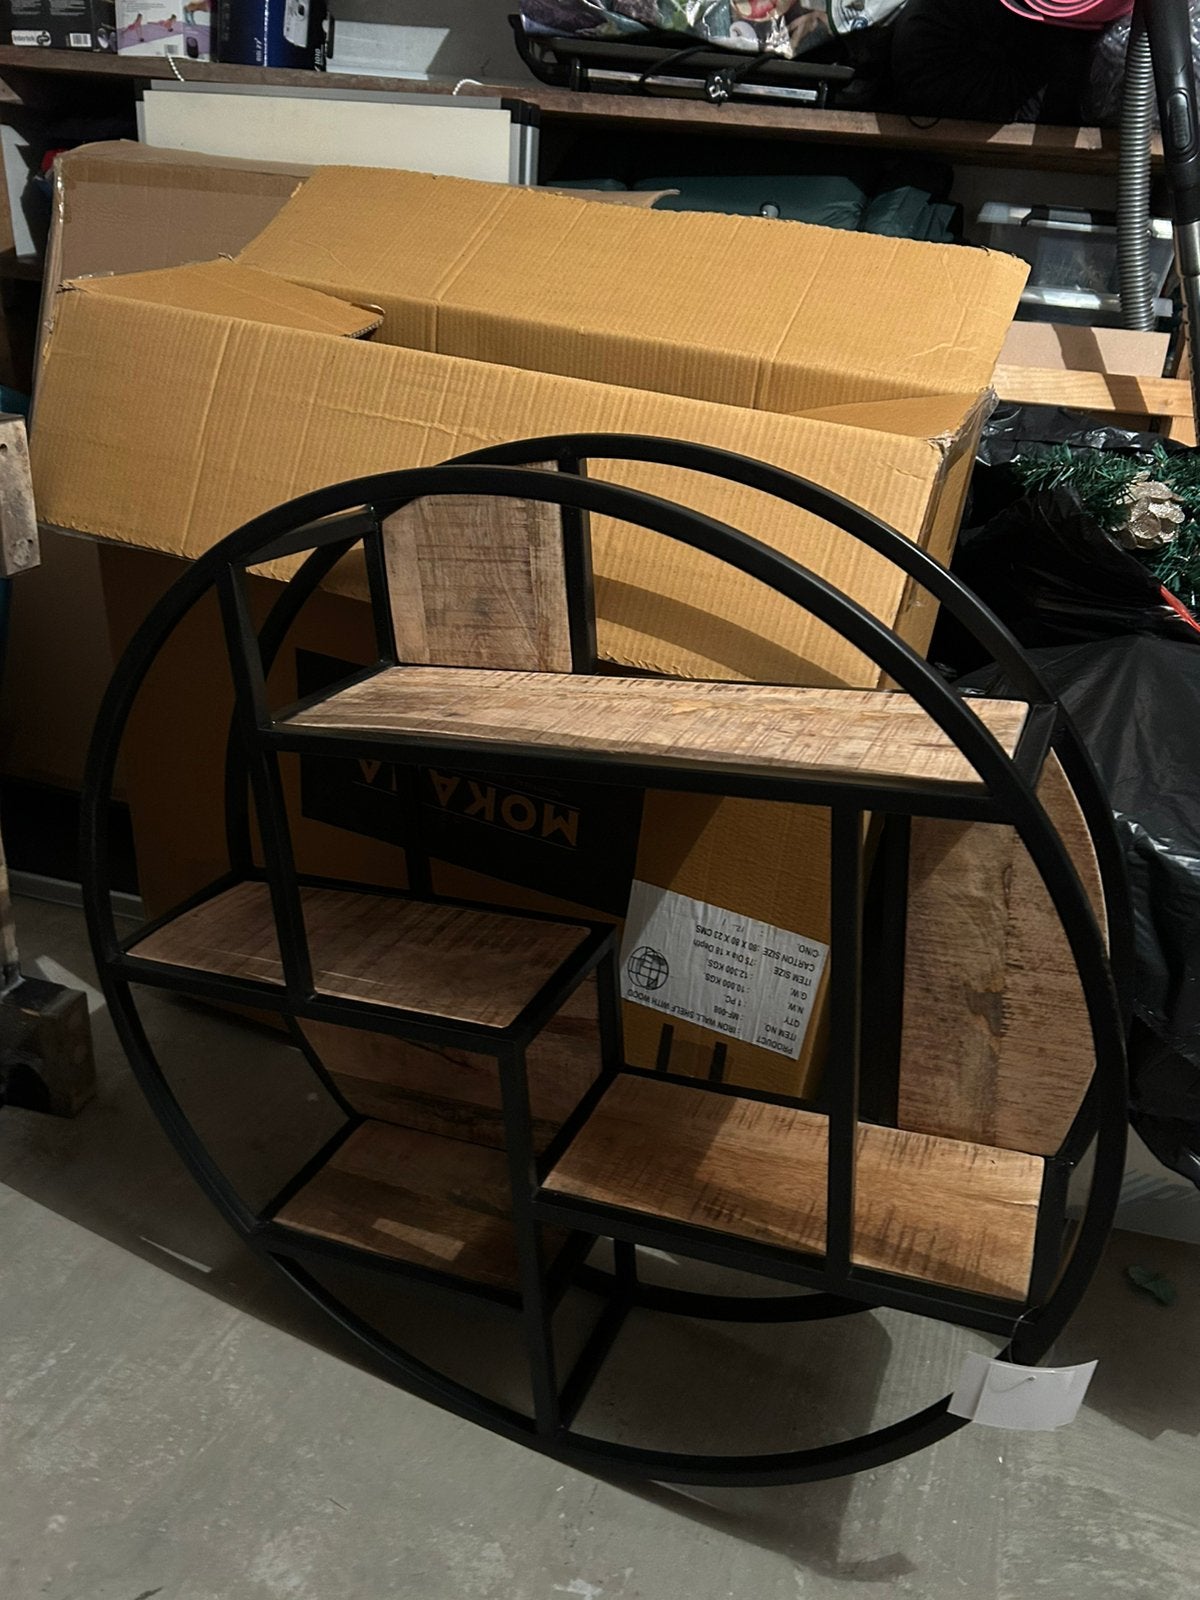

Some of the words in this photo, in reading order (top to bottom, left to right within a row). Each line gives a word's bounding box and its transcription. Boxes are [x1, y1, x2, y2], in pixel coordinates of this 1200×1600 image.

[693, 939, 714, 952] Depth
[763, 947, 781, 960] SIZE
[782, 953, 815, 972] CARTON
[773, 966, 791, 979] SIZE
[793, 974, 812, 986] ITEM
[627, 989, 651, 1002] WOOD
[651, 997, 670, 1010] WITH
[671, 1005, 694, 1019] SHELF
[696, 1013, 716, 1027] WALL
[784, 1016, 800, 1028] QTY
[718, 1022, 737, 1034] IRON
[780, 1028, 797, 1041] ITEM
[757, 1035, 793, 1055] PRODUCT
